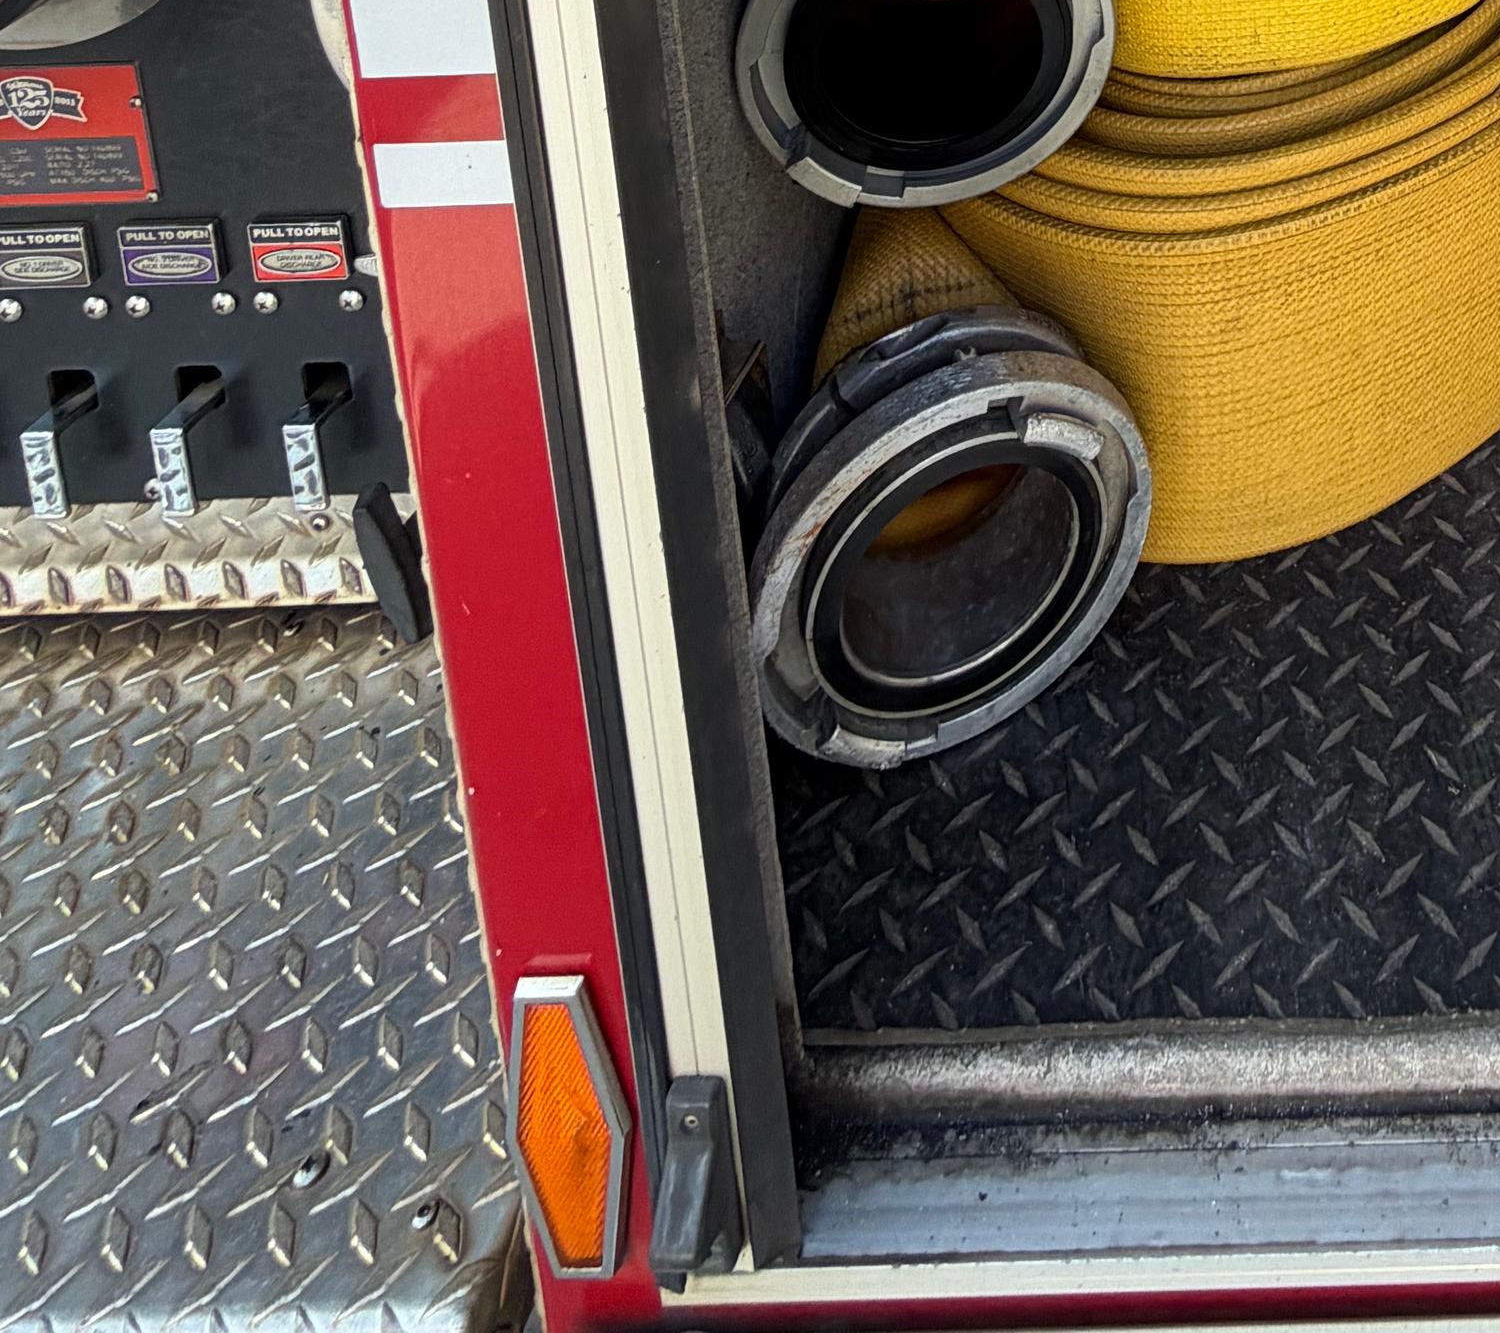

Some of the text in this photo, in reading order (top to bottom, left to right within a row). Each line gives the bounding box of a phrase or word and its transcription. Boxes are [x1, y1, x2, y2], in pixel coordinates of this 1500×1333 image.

[7, 87, 50, 109] 125
[125, 229, 209, 242] PULL TO OPEN
[252, 226, 338, 238] PULL TO OPEN
[26, 233, 44, 244] TO
[45, 233, 80, 243] OPEN
